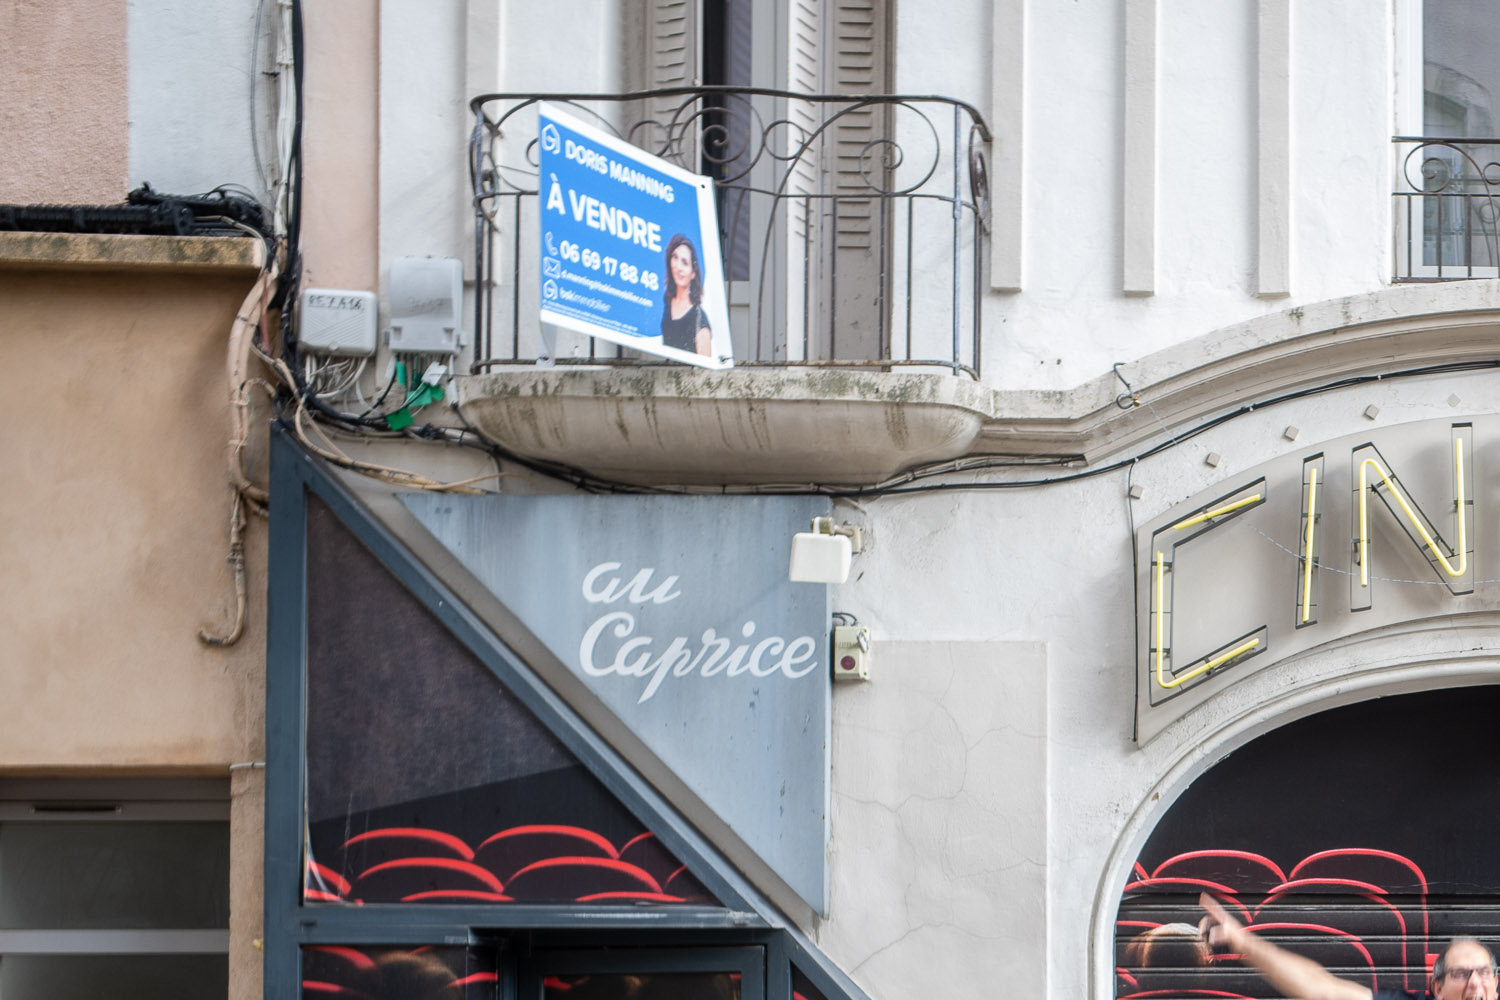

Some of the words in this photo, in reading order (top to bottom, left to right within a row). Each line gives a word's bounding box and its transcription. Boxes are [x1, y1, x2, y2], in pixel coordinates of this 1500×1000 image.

[564, 139, 608, 174] DORIS
[609, 160, 675, 203] MANNING
[546, 172, 566, 215] À
[568, 189, 663, 253] VENDRE
[560, 240, 580, 263] 06
[581, 248, 601, 270] 69
[602, 256, 618, 276] 17
[619, 262, 639, 284] 88
[640, 269, 659, 291] 48
[582, 561, 681, 604] au
[579, 611, 818, 704] Caprice
